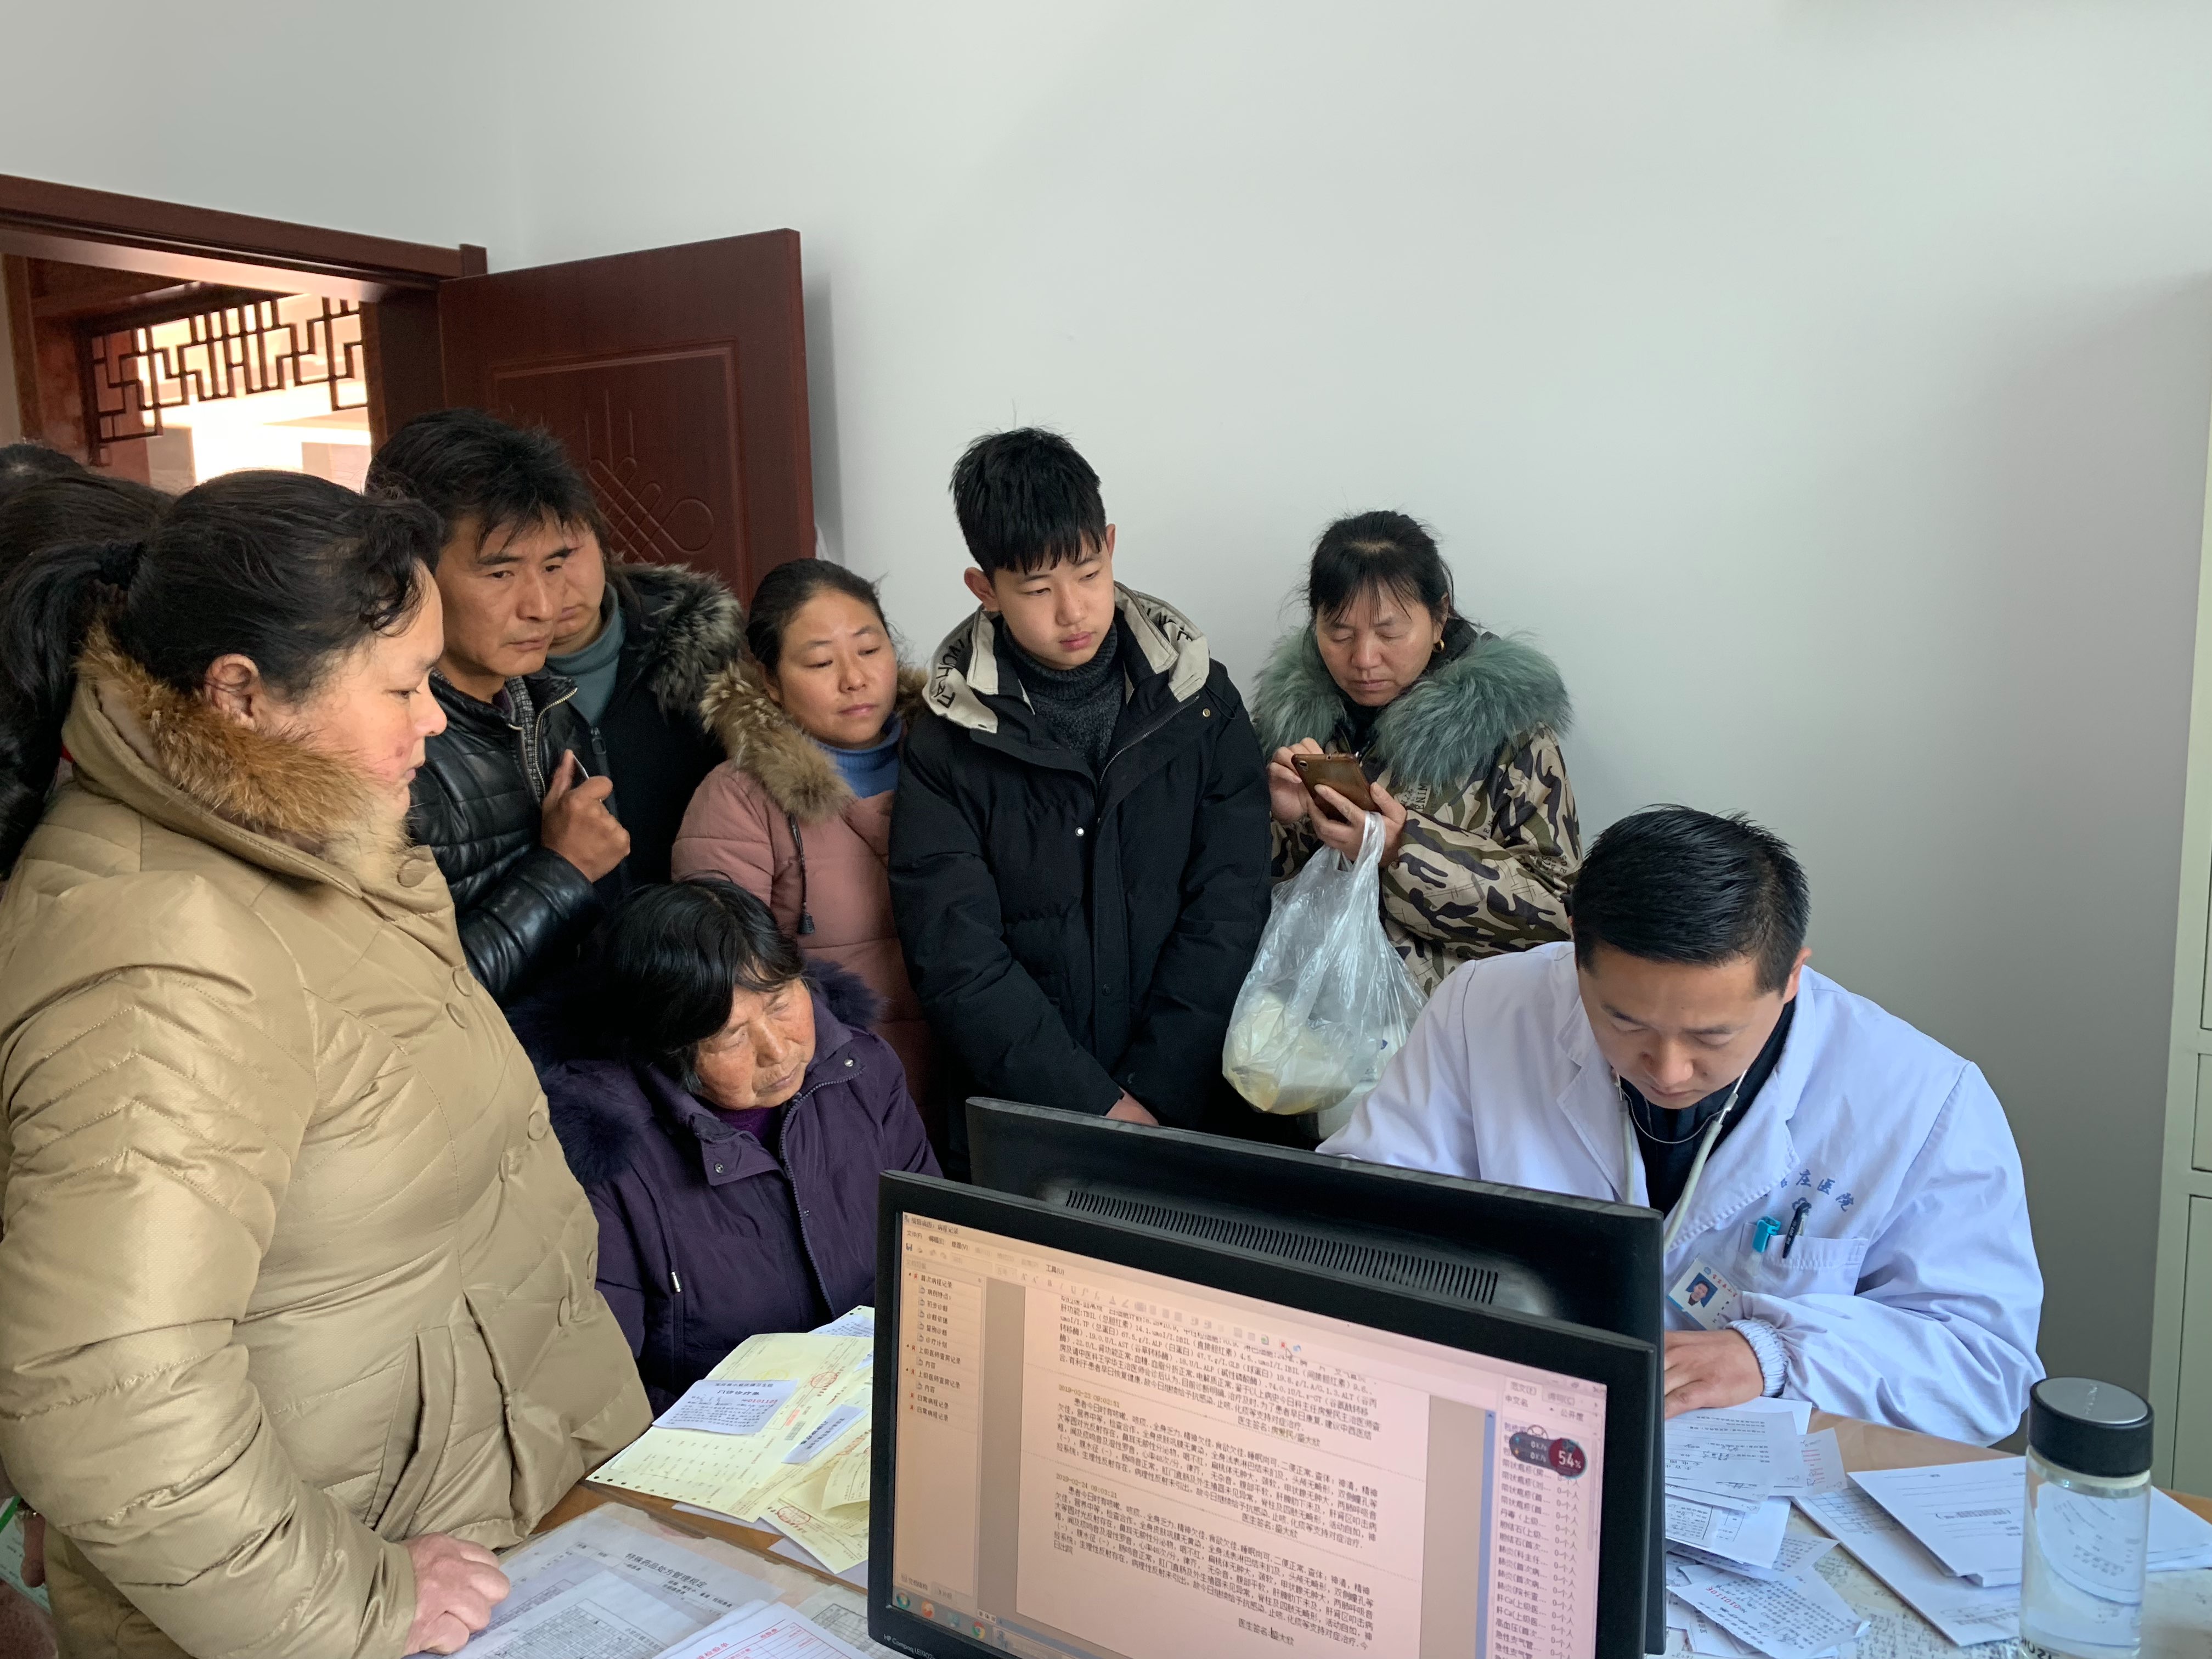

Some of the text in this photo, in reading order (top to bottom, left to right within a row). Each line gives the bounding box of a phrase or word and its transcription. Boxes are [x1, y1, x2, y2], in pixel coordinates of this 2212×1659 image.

[1046, 1263, 1064, 1276] 工具(U)
[926, 1336, 947, 1348] 诊疗计划
[919, 1346, 961, 1365] 上级医师查房记录
[925, 1359, 935, 1370] 内容
[918, 1370, 960, 1390] 上级医师查房记录
[924, 1384, 935, 1394] 内容
[917, 1393, 948, 1410] 日常病程记录
[917, 1405, 948, 1422] 日常病程记录
[625, 1552, 708, 1588] 特殊药品处方管理规定
